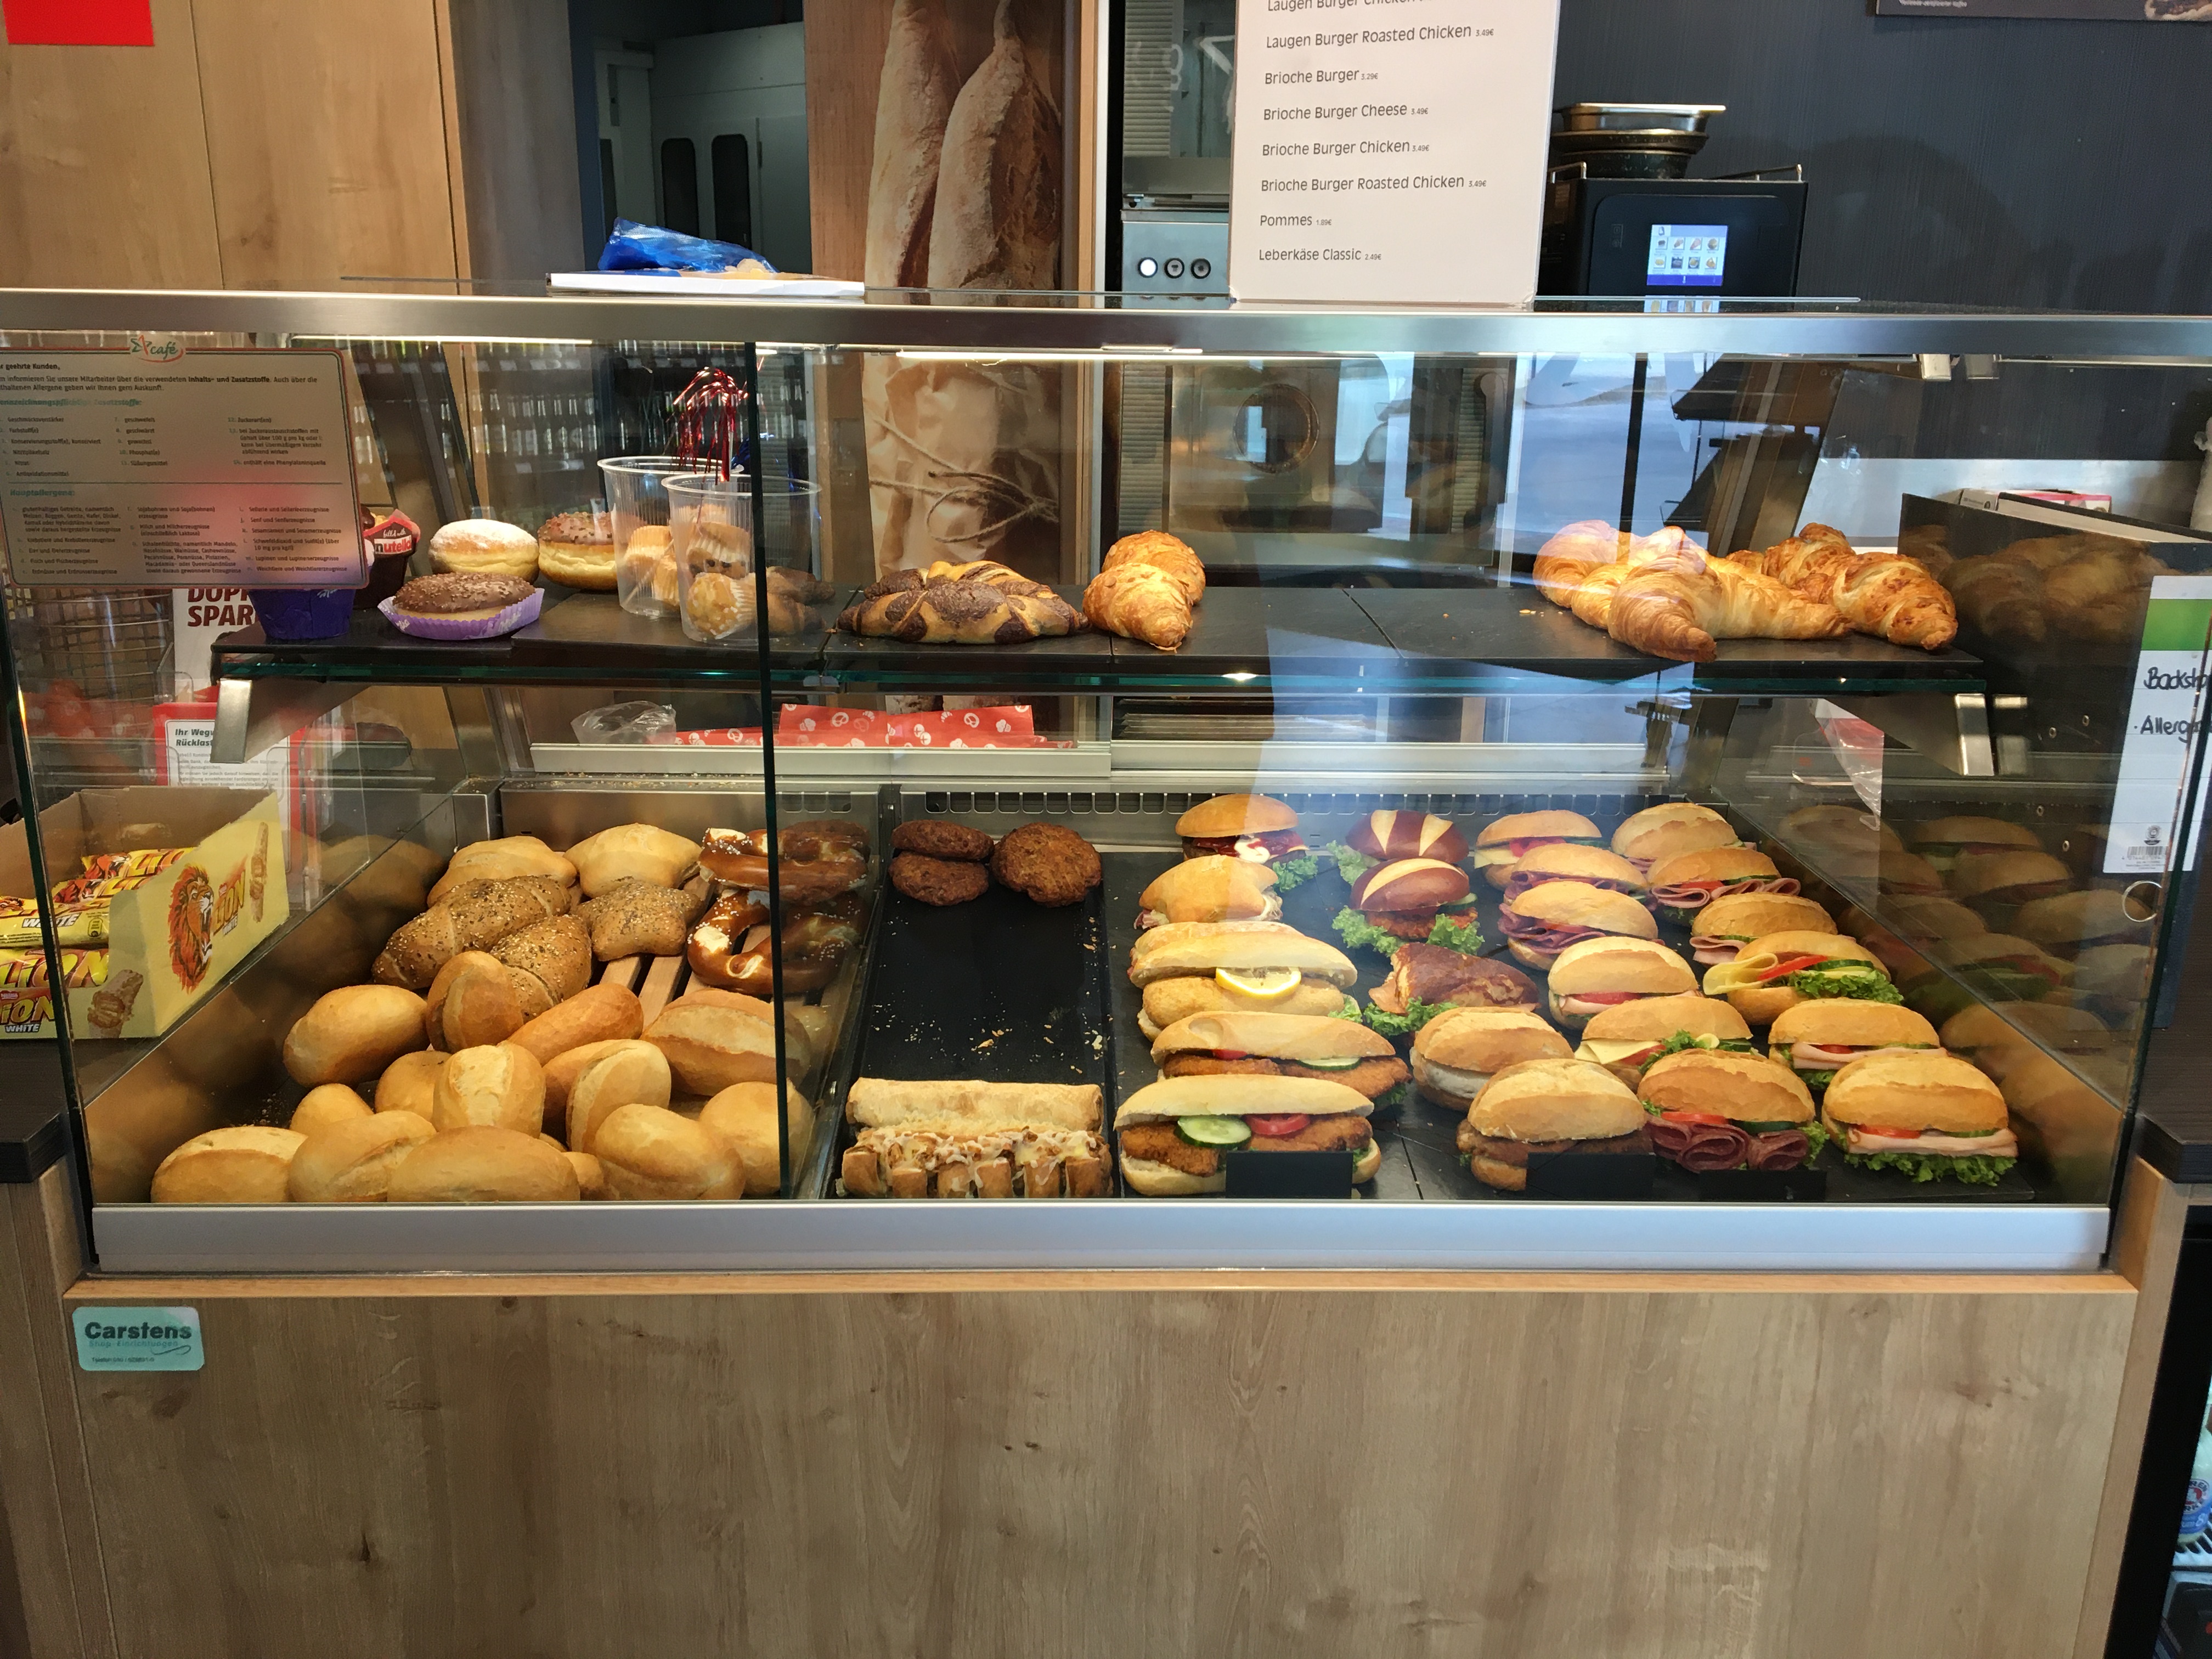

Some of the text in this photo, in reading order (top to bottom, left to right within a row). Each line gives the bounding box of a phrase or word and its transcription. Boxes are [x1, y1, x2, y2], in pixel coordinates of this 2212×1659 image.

[1268, 0, 1312, 12] Laugen
[1267, 36, 1311, 49] Laugen
[1316, 33, 1358, 46] Burger
[1363, 27, 1415, 42] Roasted
[1419, 25, 1471, 40] Chicken
[1265, 71, 1312, 84] Brioche
[1317, 70, 1359, 83] Burger
[1264, 108, 1311, 120] Brioche
[1315, 107, 1358, 120] Burger
[1362, 104, 1407, 116] Cheese
[1263, 143, 1309, 156] Brioche
[1313, 143, 1356, 156] Burger
[1360, 140, 1409, 153] Chicken
[1262, 179, 1307, 191] Brioche
[1312, 179, 1353, 192] Burger
[1358, 177, 1409, 189] Roasted
[1413, 176, 1464, 188] Chicken
[1260, 215, 1312, 226] Pommes
[1260, 249, 1319, 260] Leberkäse
[1323, 248, 1361, 260] Classic
[375, 539, 411, 553] nutella
[188, 605, 259, 627] SPAR
[22, 913, 80, 927] WTE
[84, 1322, 192, 1339] Carstens
